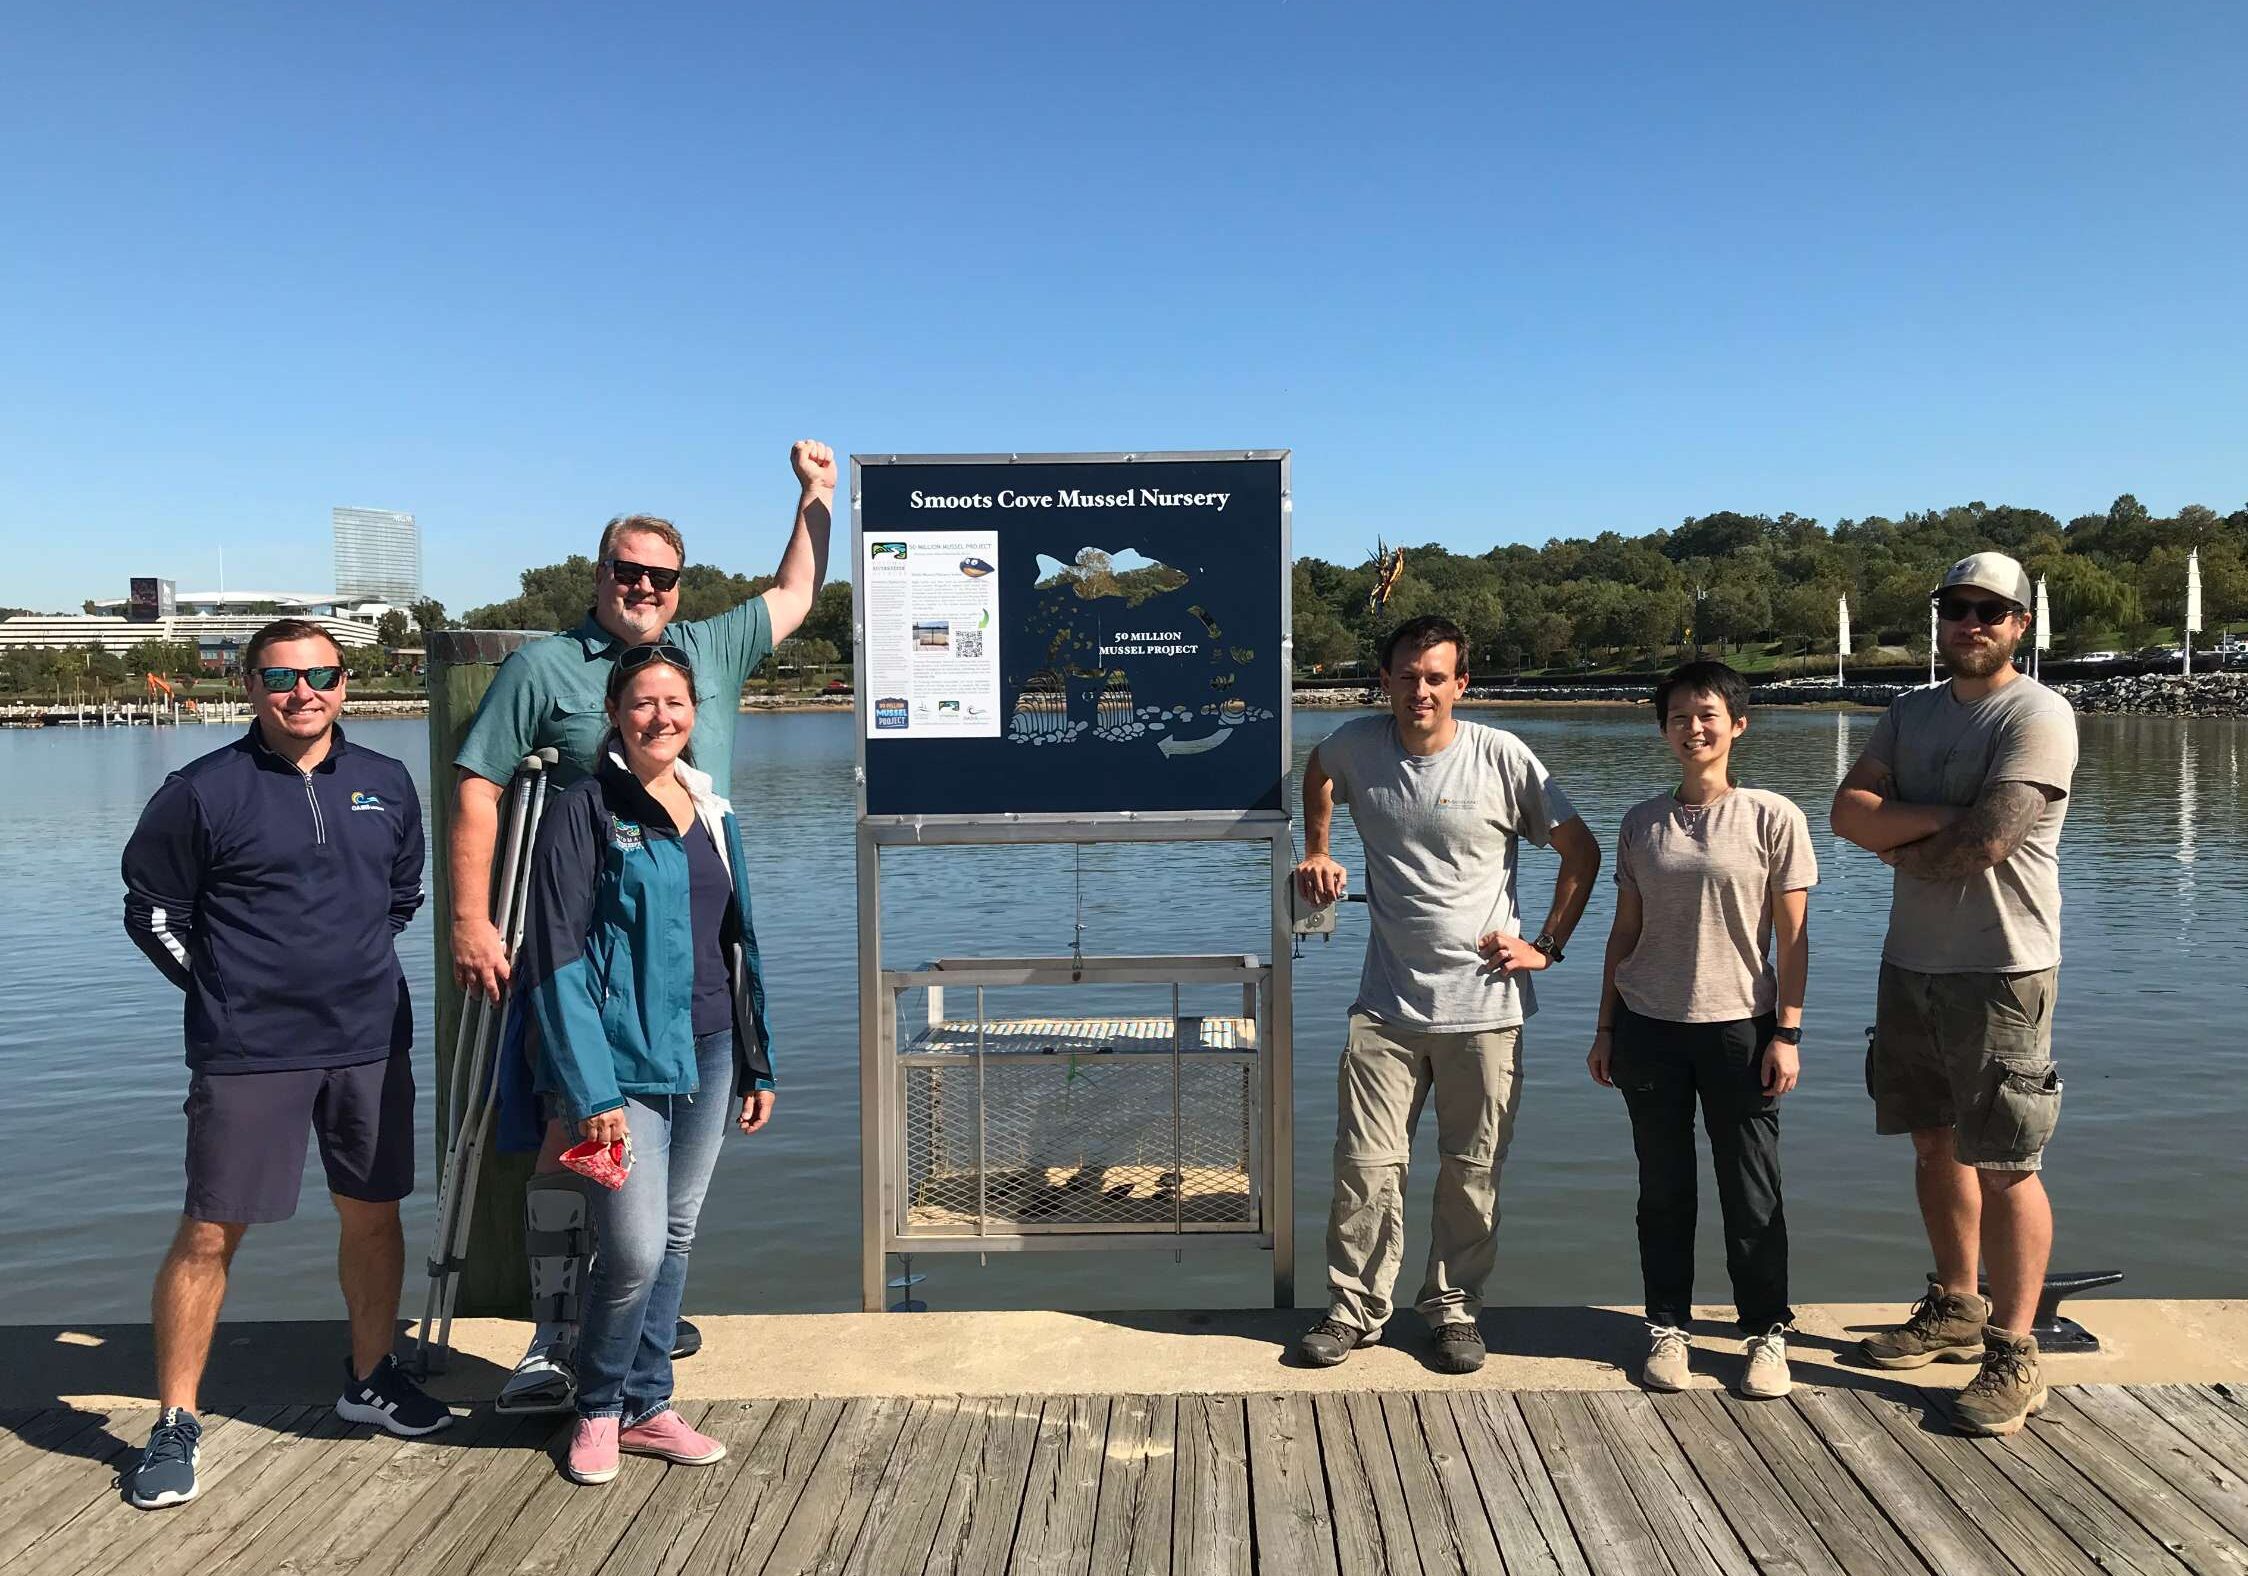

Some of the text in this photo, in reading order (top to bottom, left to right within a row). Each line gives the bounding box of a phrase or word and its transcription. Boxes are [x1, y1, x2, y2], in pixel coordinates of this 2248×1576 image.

[911, 488, 1231, 511] Smoots Cove Mussel Nursery
[1114, 631, 1182, 643] 50 MILLION
[1099, 645, 1198, 656] MUSSEL PROJECT
[876, 709, 907, 717] MUSSEL
[879, 717, 906, 725] PROJECT
